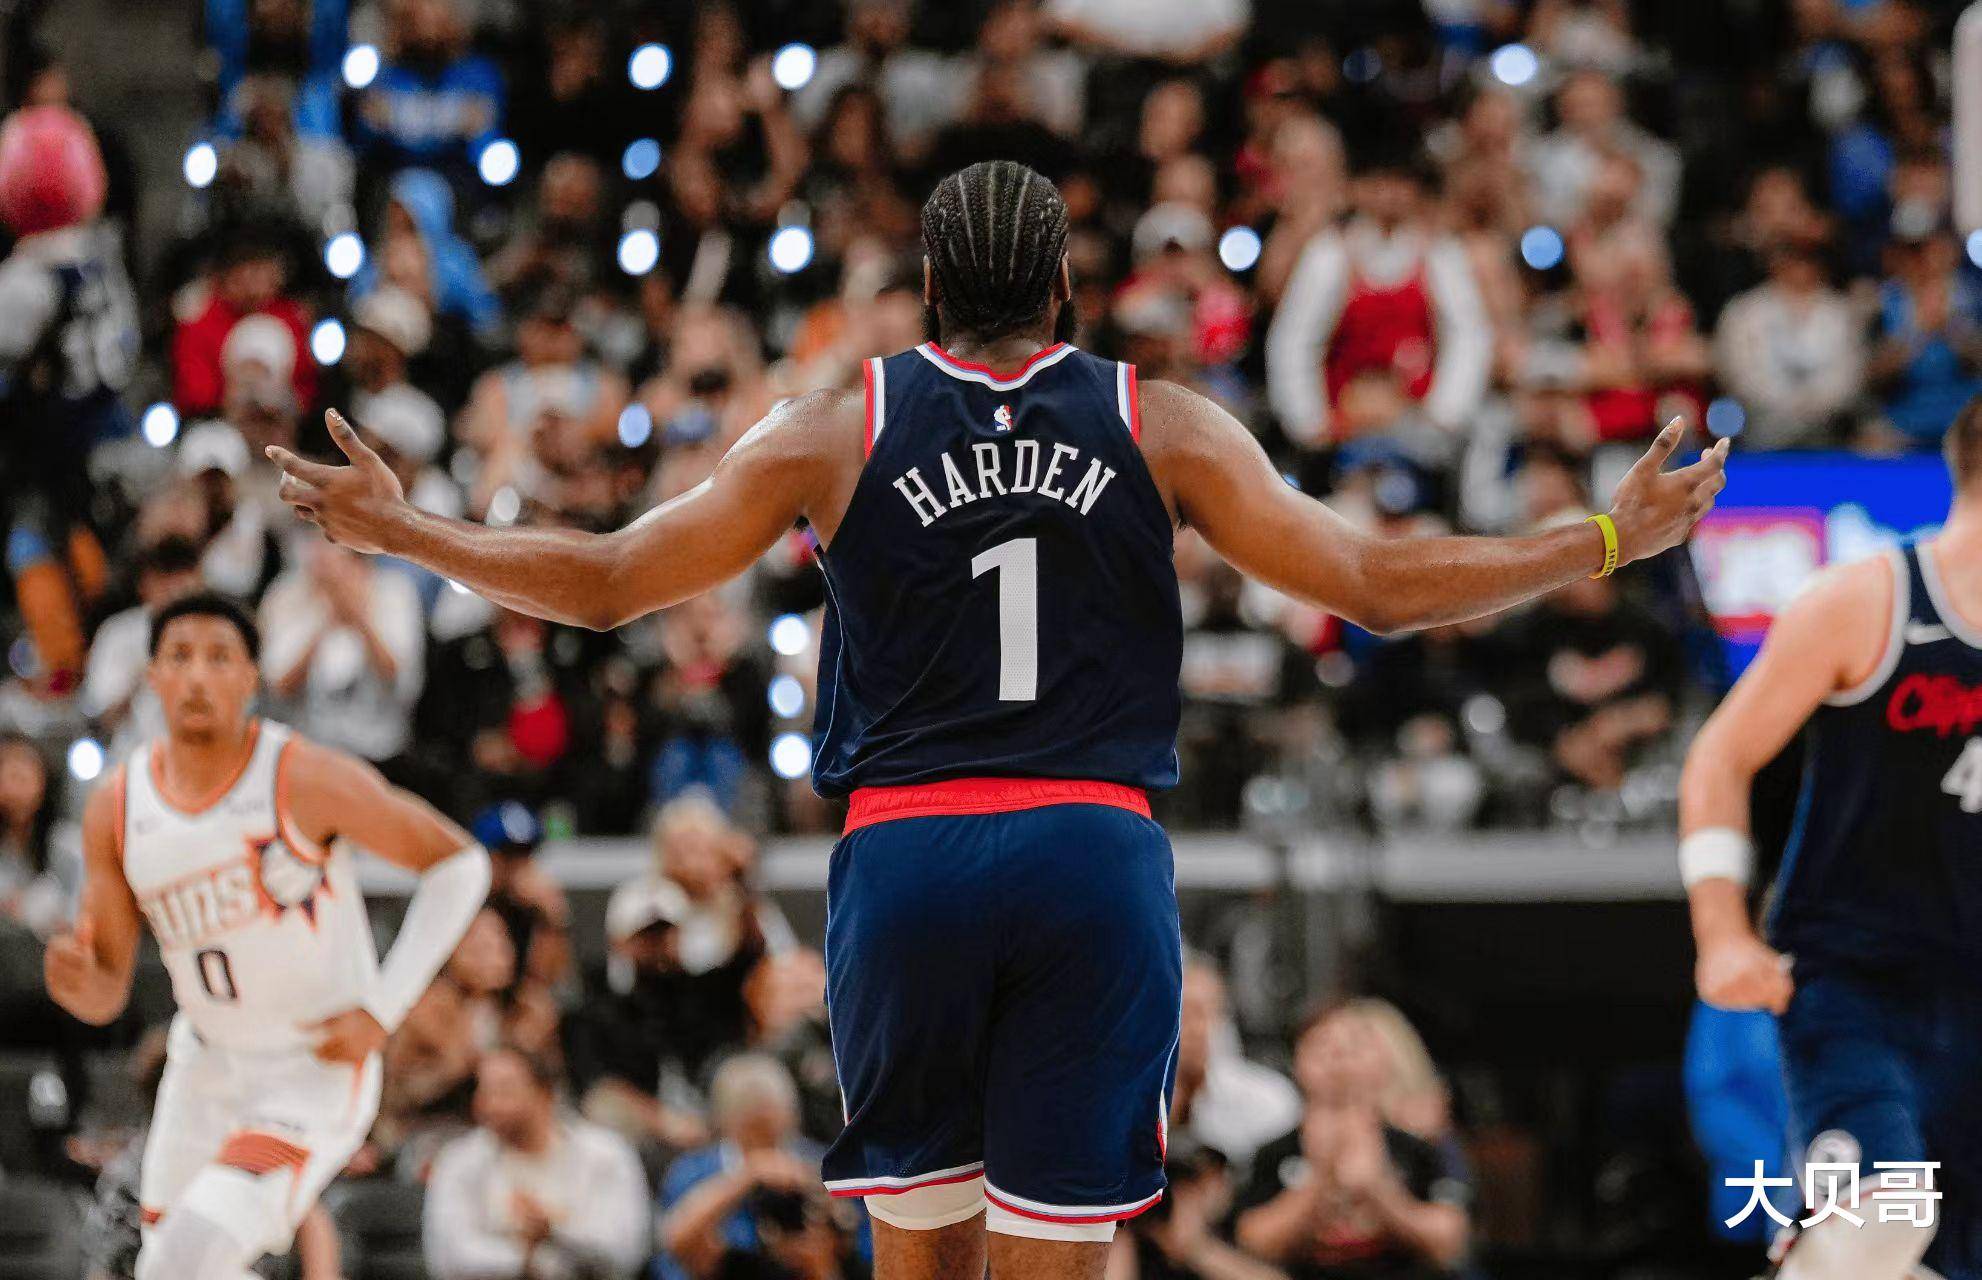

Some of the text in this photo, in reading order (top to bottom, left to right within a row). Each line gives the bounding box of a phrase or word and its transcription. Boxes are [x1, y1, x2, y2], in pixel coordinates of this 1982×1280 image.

[893, 439, 1117, 528] HARDEN
[971, 537, 1038, 700] 1
[197, 947, 239, 1001] 0
